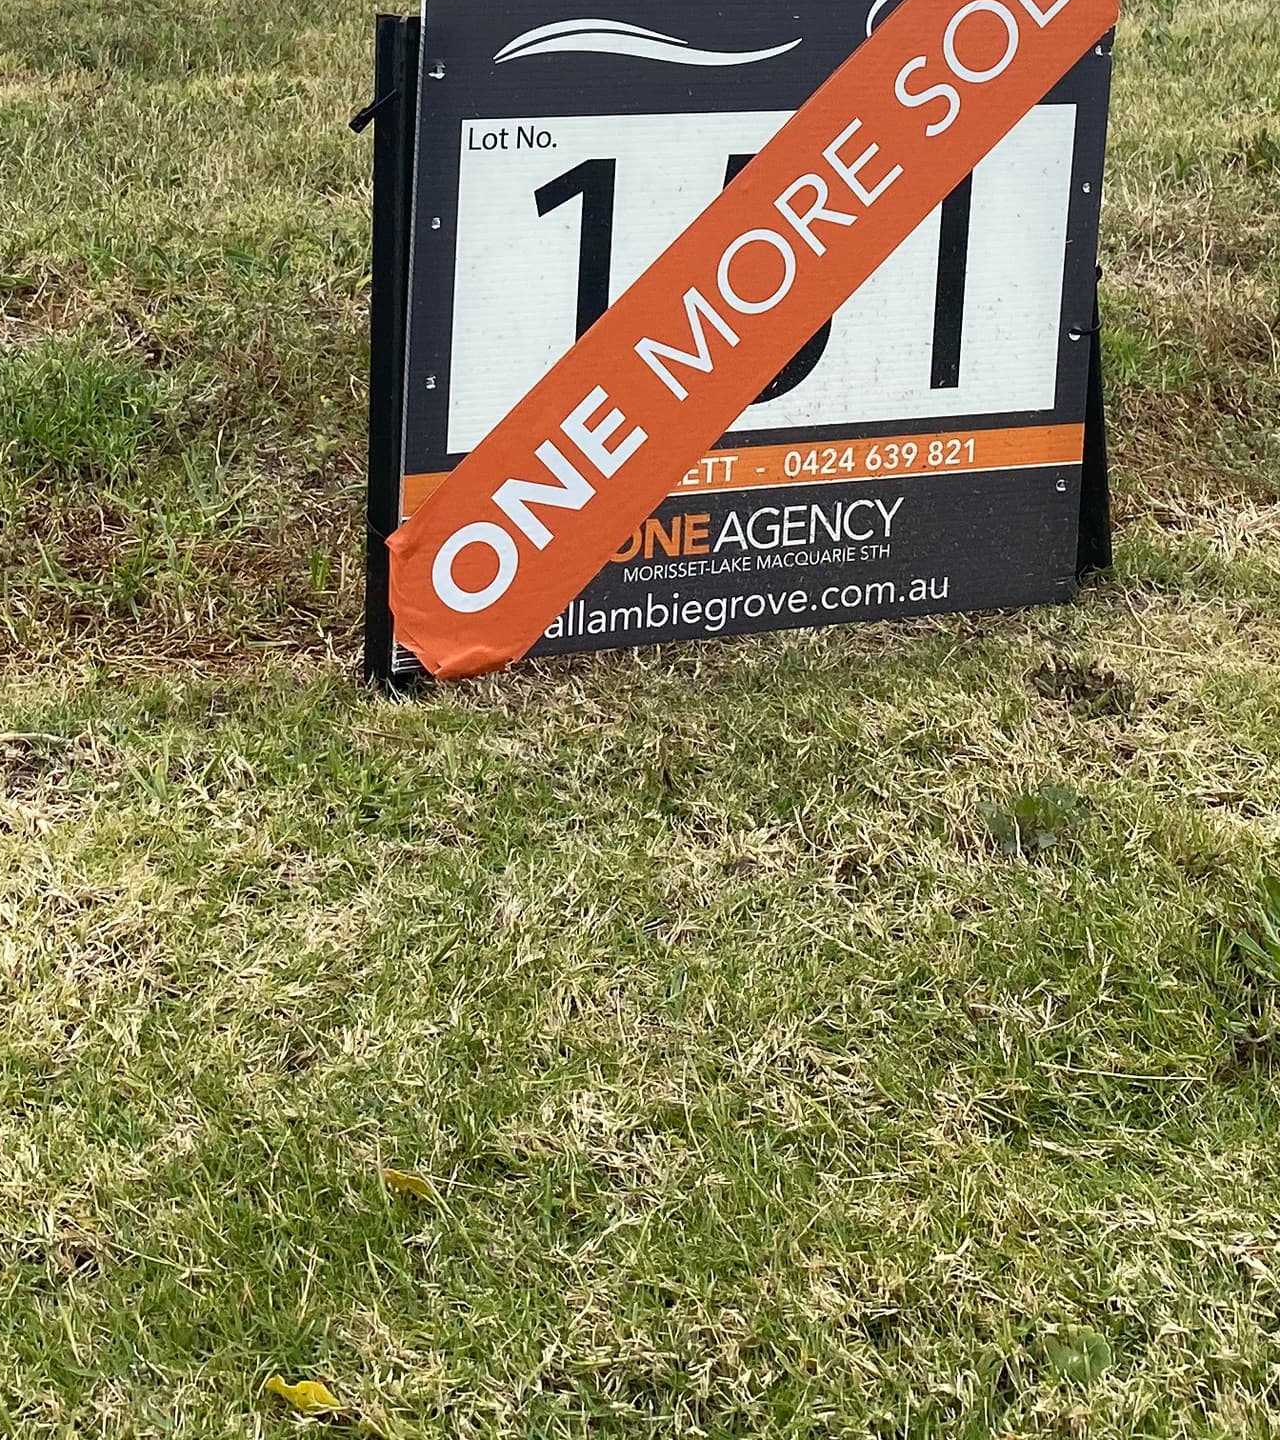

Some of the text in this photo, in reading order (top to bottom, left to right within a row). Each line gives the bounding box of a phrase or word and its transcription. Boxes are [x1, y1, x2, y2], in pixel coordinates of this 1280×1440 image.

[468, 125, 557, 150] Lot No.
[534, 154, 973, 405] 11
[431, 385, 648, 614] ONE
[634, 118, 904, 402] MORE
[677, 456, 738, 486] ETT
[783, 448, 855, 477] 0424
[865, 443, 918, 471] 639
[927, 439, 977, 466] 821
[623, 543, 891, 583] MORISSET-LAKE MACQUARIE STH
